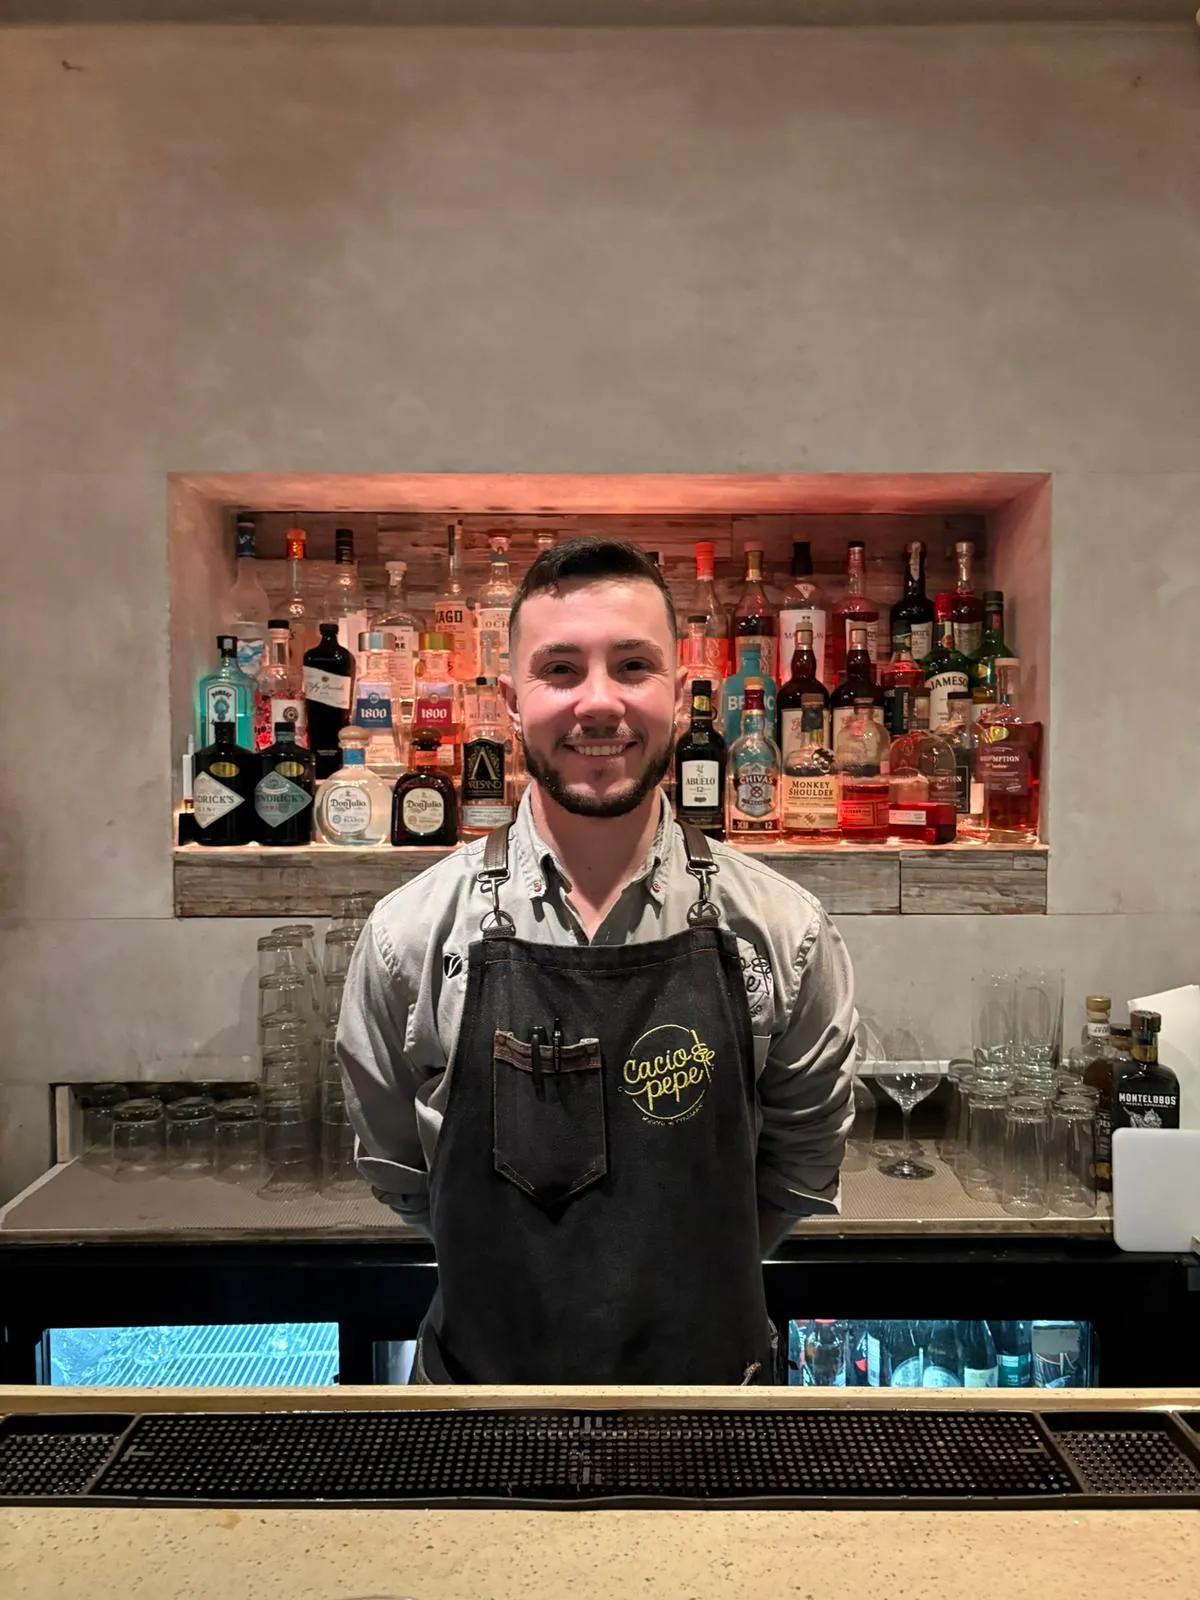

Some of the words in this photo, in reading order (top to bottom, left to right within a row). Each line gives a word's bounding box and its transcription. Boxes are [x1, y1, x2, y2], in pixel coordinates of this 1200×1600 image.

[485, 621, 510, 629] OCH
[930, 675, 968, 690] JAMESO
[361, 708, 387, 719] 1800
[421, 708, 447, 719] 1800
[685, 777, 716, 785] ABUELO
[739, 774, 774, 785] CHIVAS
[791, 781, 830, 789] MONKEY
[788, 788, 833, 797] SHOULDER
[197, 795, 234, 804] DRICK'S
[765, 821, 773, 829] 12
[646, 1067, 704, 1111] pepe
[1118, 1092, 1177, 1106] MONTELOBOS
